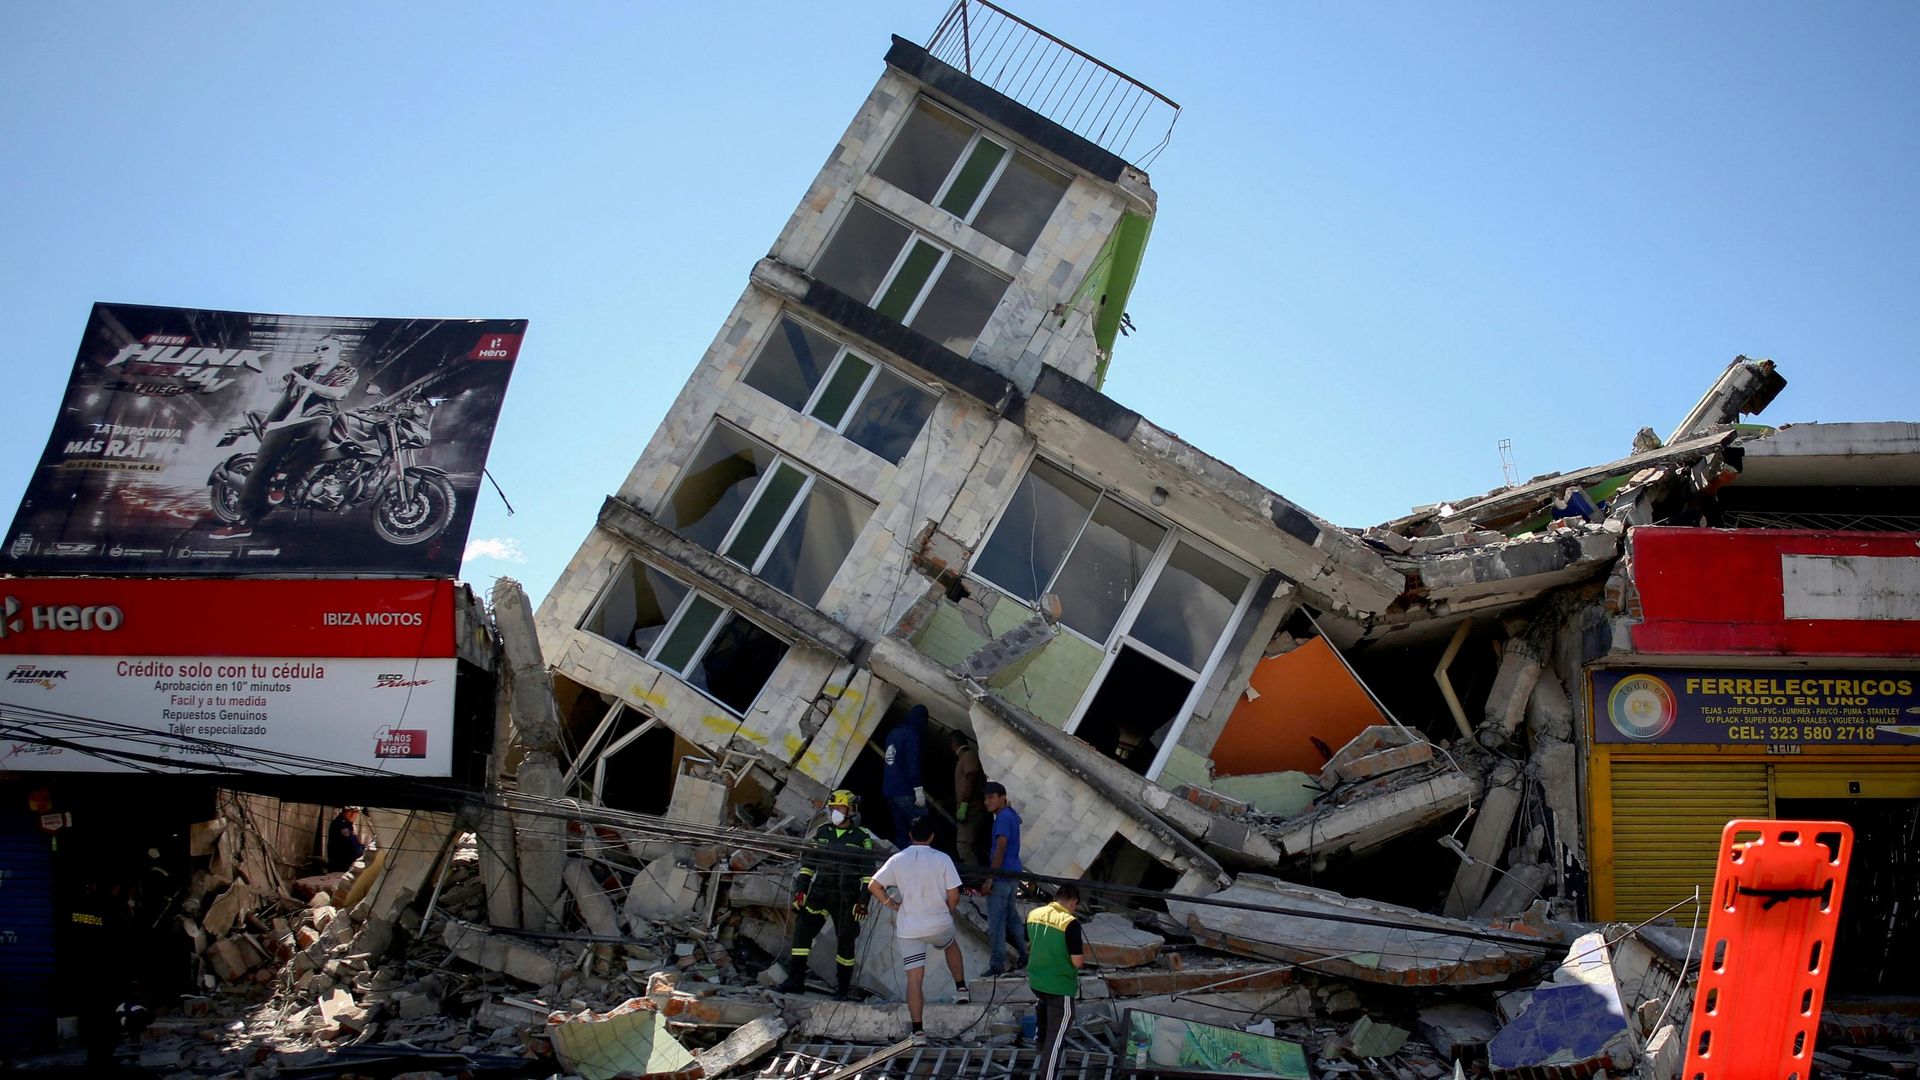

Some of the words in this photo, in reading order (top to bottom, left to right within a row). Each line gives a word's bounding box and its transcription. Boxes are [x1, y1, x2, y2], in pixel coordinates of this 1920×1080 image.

[147, 335, 187, 344] NUEVA
[105, 343, 274, 374] HUNK
[94, 425, 109, 434] LA
[112, 426, 182, 438] DEPORTIVA
[64, 438, 104, 453] MÁS
[103, 437, 189, 459] RÁPID
[104, 462, 127, 470] km/h
[32, 604, 124, 631] Hero
[323, 612, 363, 625] IBIZA
[365, 612, 423, 626] MOTOS
[6, 669, 70, 680] HUNK
[116, 660, 174, 678] Crédito
[179, 662, 212, 678] solo
[218, 666, 246, 678] con
[252, 664, 266, 679] tu
[272, 662, 325, 679] cédula
[154, 680, 213, 692] Aprobación
[215, 683, 228, 691] en
[250, 682, 291, 692] minutos
[1686, 678, 1913, 696] FERRELECTRICOS
[171, 695, 195, 706] Facil
[198, 698, 204, 708] y
[207, 698, 213, 706] a
[216, 696, 226, 706] tu
[229, 695, 267, 707] medida
[1733, 696, 1787, 705] TODO
[1794, 697, 1820, 705] EN
[1826, 697, 1869, 706] UNO
[162, 709, 216, 722] Repuestos
[219, 709, 268, 721] Genuinos
[1782, 707, 1811, 715] LUMINEX
[1816, 707, 1838, 715] PAVCO
[1867, 708, 1900, 716] STANTLEY
[1705, 716, 1716, 724] GY
[1716, 716, 1739, 724] PLACK
[1744, 716, 1767, 724] SUPER
[168, 723, 196, 735] Taller
[198, 724, 267, 736] especializado
[373, 725, 391, 741] 4
[1728, 726, 1764, 740] CEL:
[1769, 726, 1799, 740] 323
[1803, 727, 1832, 740] 580
[1837, 727, 1876, 740] 2718
[388, 733, 412, 743] AÑOS
[380, 745, 411, 754] Hero
